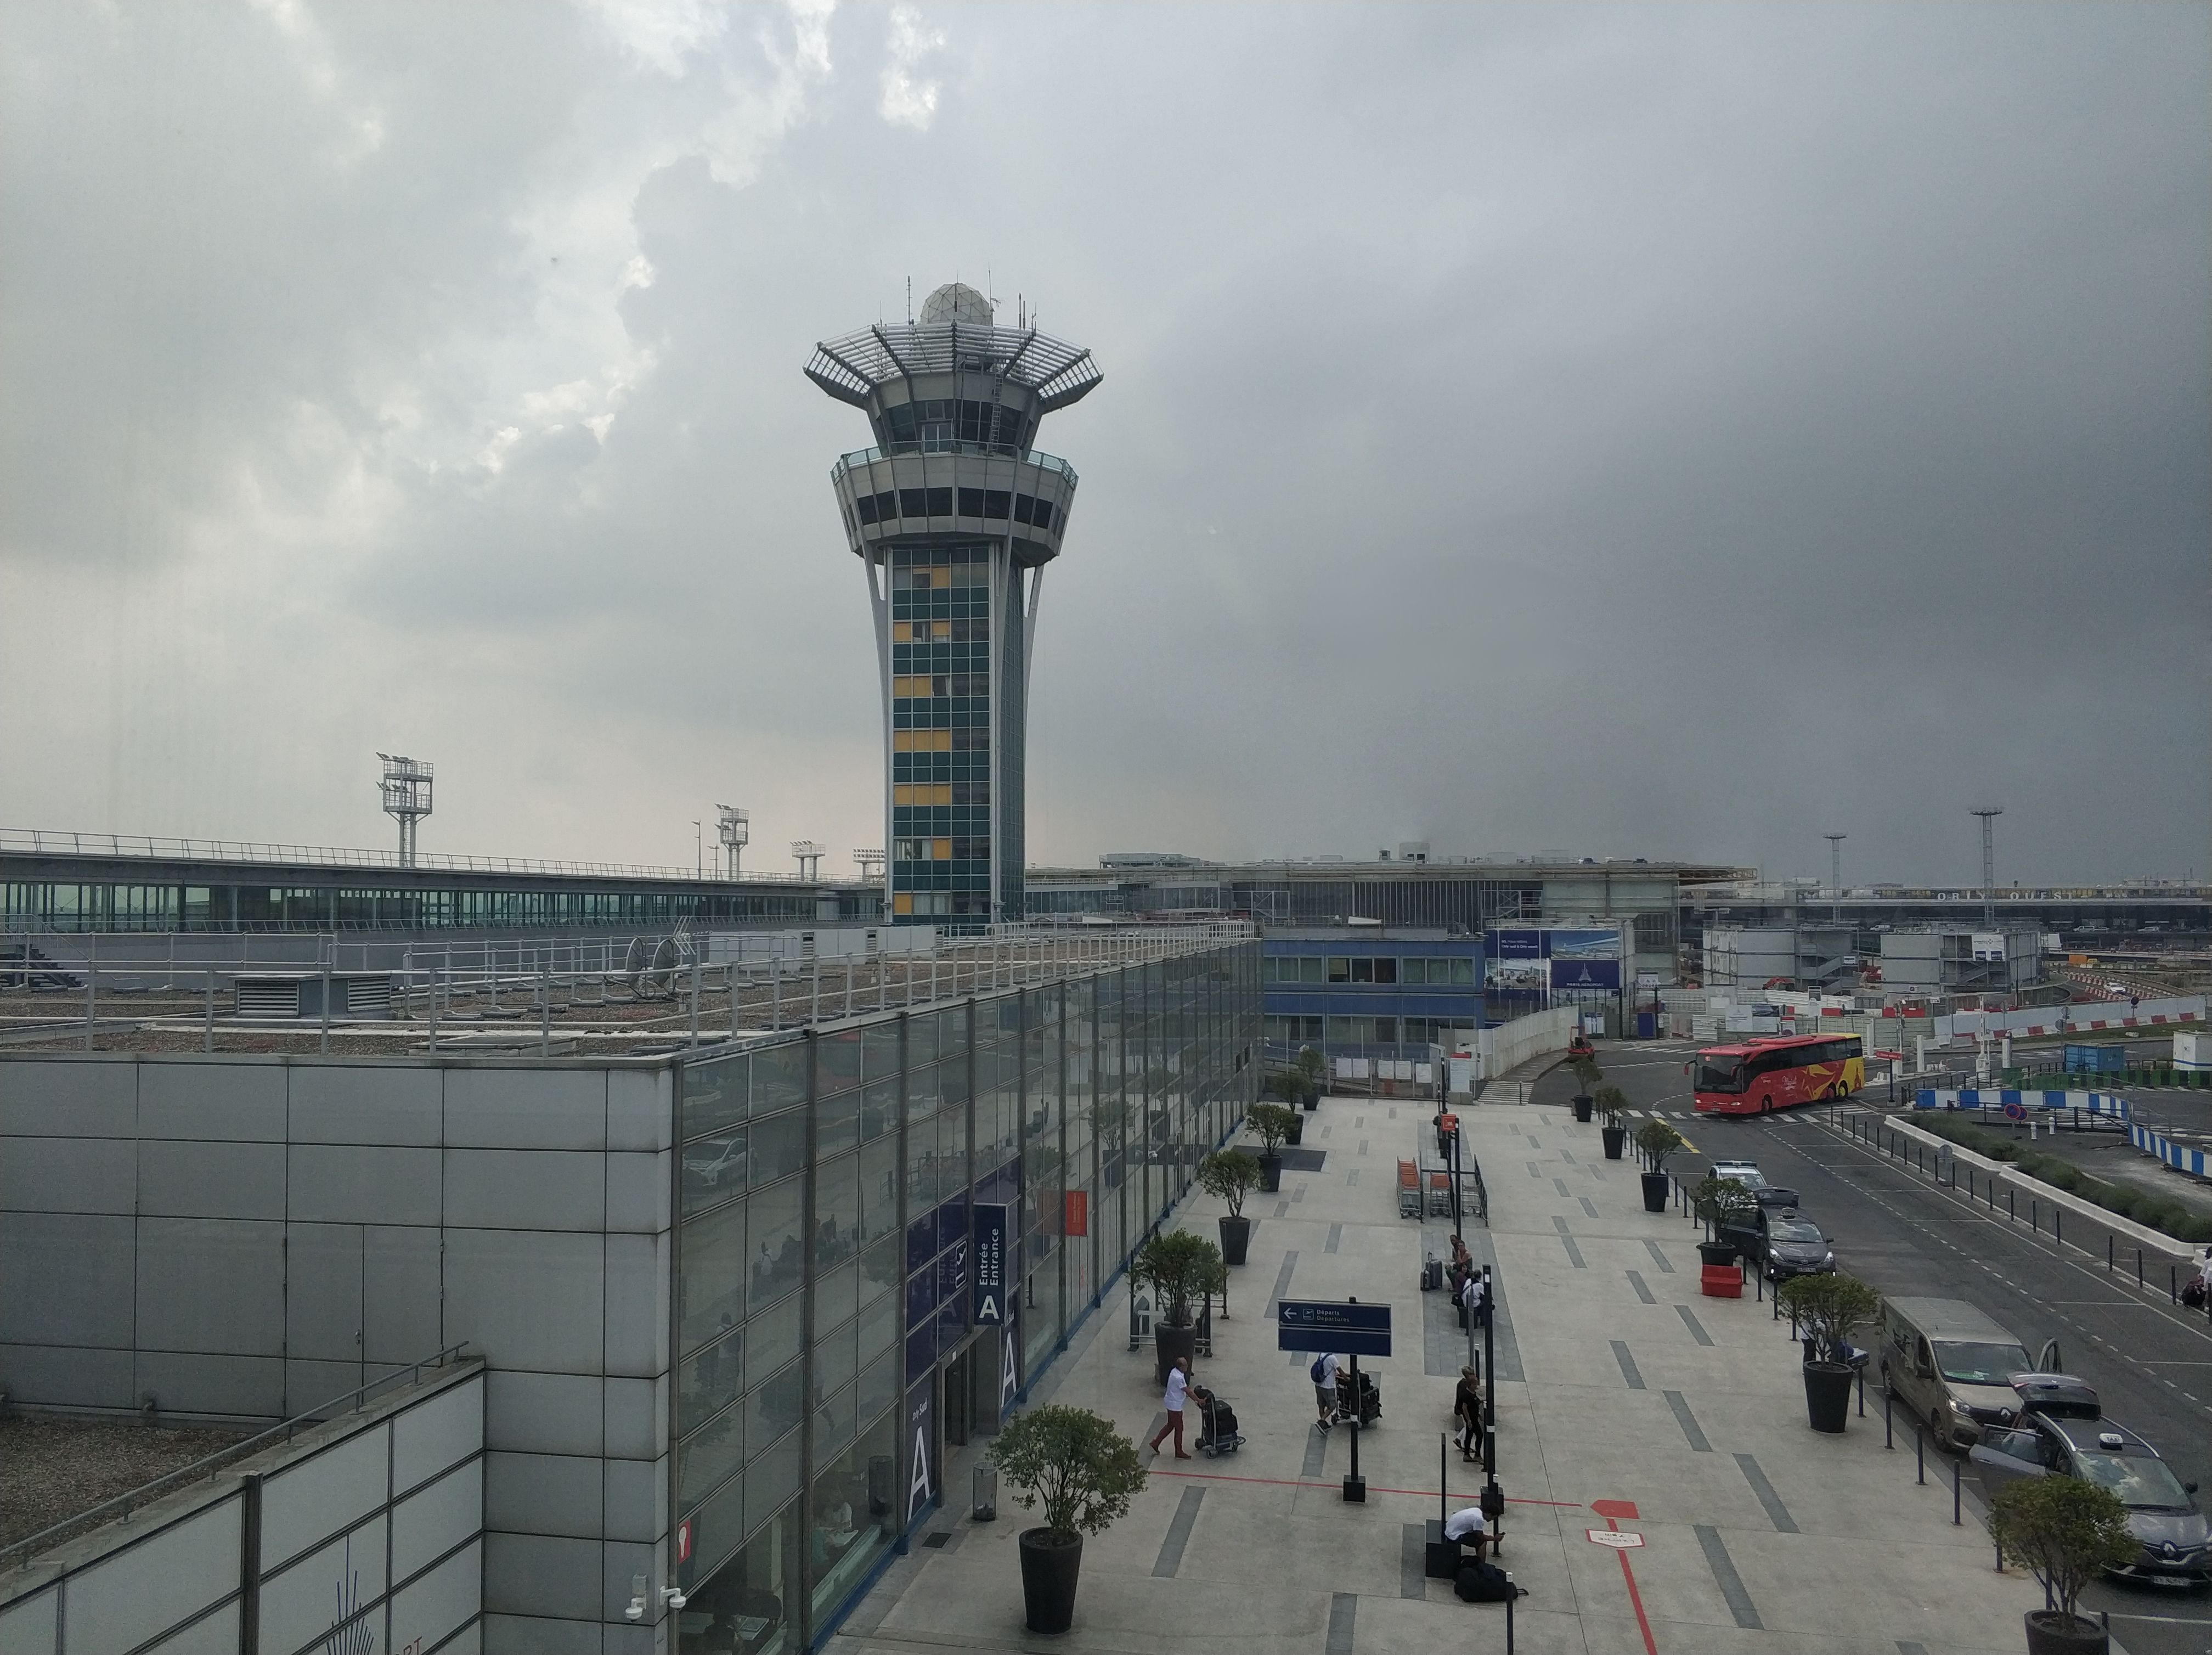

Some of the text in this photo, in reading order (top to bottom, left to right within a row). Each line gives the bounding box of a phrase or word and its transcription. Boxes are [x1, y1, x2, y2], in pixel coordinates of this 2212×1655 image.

[1937, 890, 2073, 900] ORLY OUEST
[979, 1243, 988, 1286] Entrée
[990, 1228, 999, 1286] Entrance
[979, 1295, 1000, 1319] A
[1001, 1331, 1016, 1409] A
[907, 1426, 930, 1524] A
